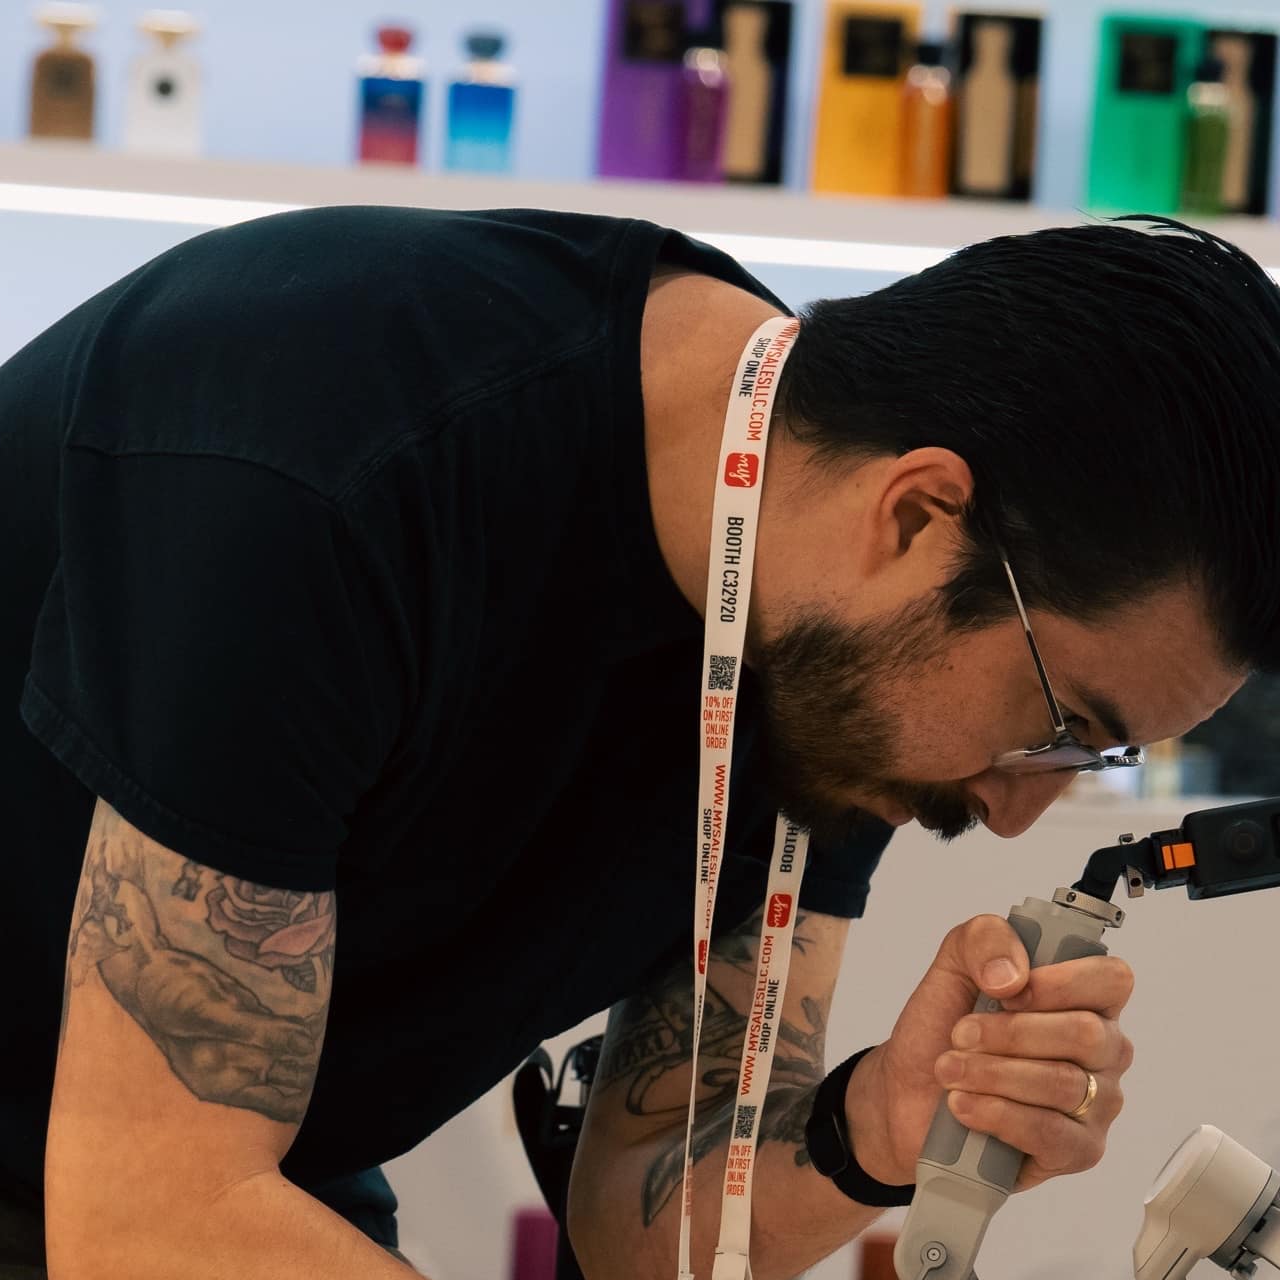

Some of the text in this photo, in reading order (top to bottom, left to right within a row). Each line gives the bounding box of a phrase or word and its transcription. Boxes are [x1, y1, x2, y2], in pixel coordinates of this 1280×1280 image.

[739, 337, 771, 398] SHOP ONLINE
[720, 516, 745, 623] BOOTH C32920
[703, 709, 733, 722] ON FIRST
[704, 696, 734, 709] 10% OFF
[705, 722, 729, 736] ONLINE
[705, 737, 727, 749] ORDER
[700, 807, 712, 885] SHOP ONLINE
[779, 824, 800, 873] BOOTH
[740, 935, 775, 1096] WWW.MYSALESLLC.COM
[759, 978, 780, 1053] SHOP ONLINE
[740, 1145, 752, 1156] OFF
